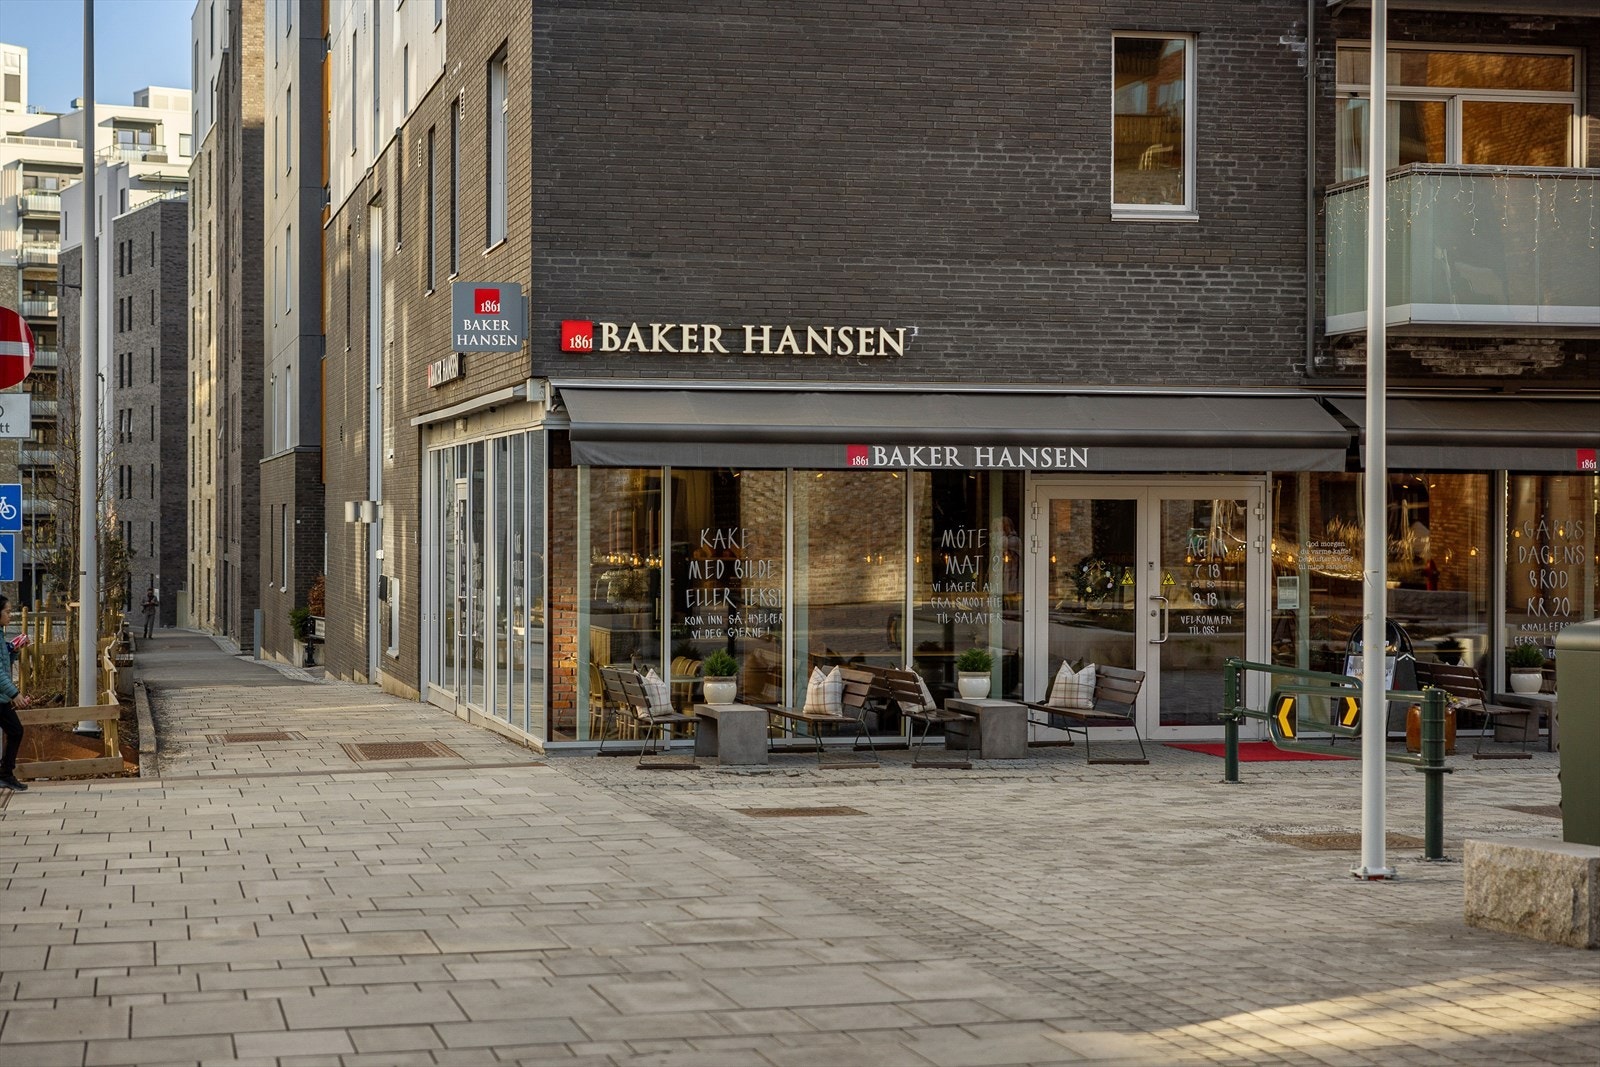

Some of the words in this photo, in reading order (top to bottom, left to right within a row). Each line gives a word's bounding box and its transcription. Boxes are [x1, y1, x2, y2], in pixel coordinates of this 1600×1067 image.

[480, 299, 501, 313] 1861
[463, 319, 511, 331] BAKER
[457, 334, 518, 346] HANSEN
[569, 334, 593, 349] 1861
[599, 322, 730, 353] BAKER
[742, 324, 907, 357] HANSEN
[852, 456, 869, 466] 1861
[872, 446, 964, 467] BAKER
[974, 446, 1089, 468] HANSEN
[1581, 459, 1597, 469] 1861
[700, 526, 751, 550] KAKE
[1519, 545, 1585, 565] DAGENS
[688, 559, 725, 580] MED
[734, 556, 777, 579] BILDE
[945, 554, 984, 575] MAT
[686, 587, 737, 608] ELLER
[931, 597, 951, 608] FRA
[1527, 596, 1549, 617] KR
[1552, 596, 1570, 617] 20
[684, 615, 704, 626] KOM
[936, 612, 951, 624] TIL
[954, 612, 1006, 625] SALATER
[1180, 615, 1232, 625] VELKOMMEN
[705, 628, 722, 639] DEG
[1188, 624, 1200, 635] TIL
